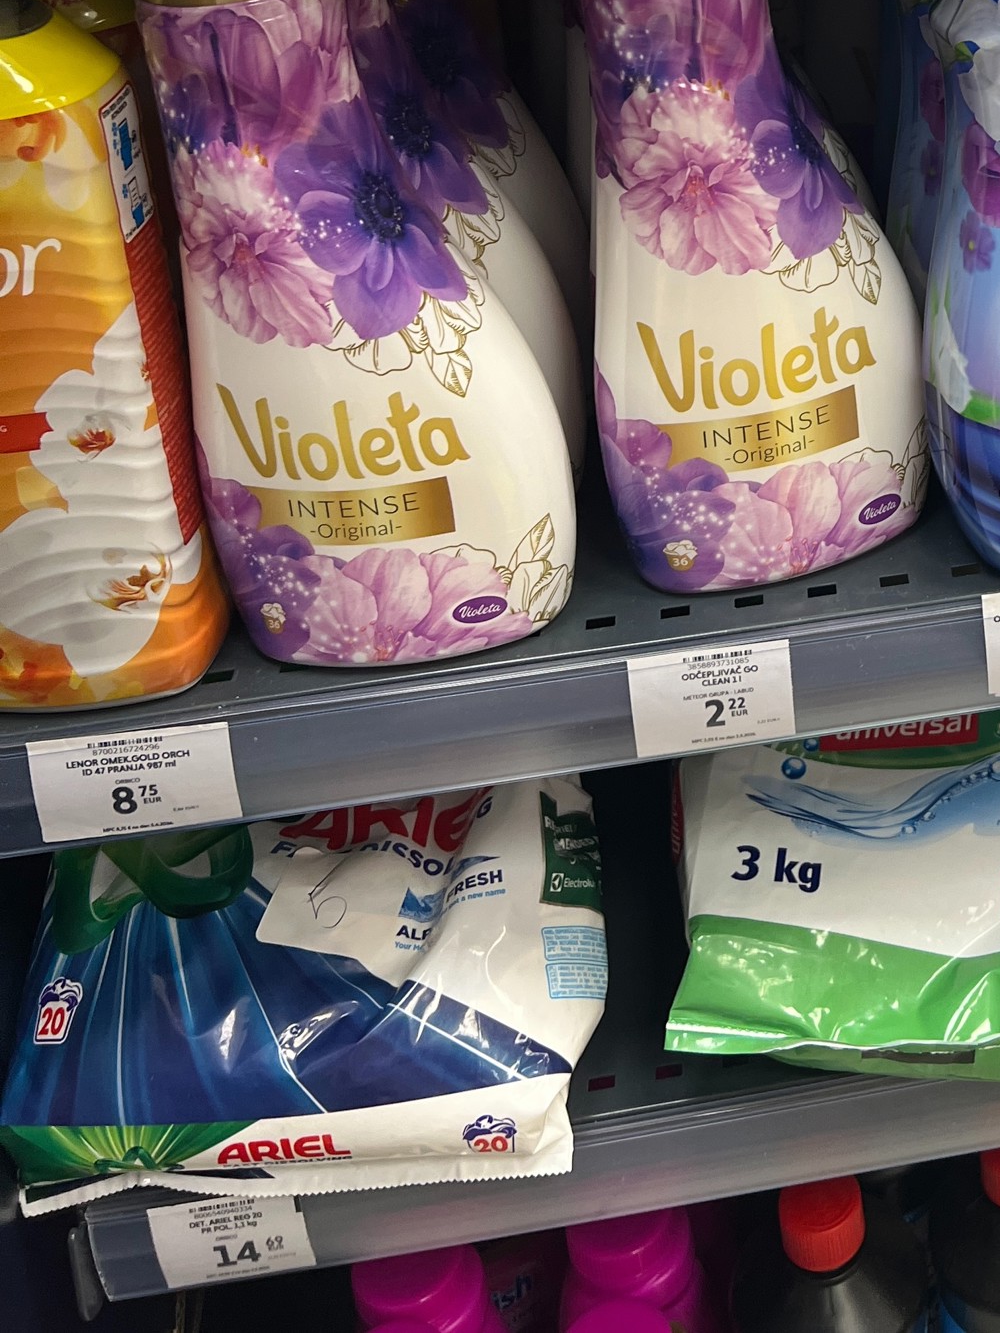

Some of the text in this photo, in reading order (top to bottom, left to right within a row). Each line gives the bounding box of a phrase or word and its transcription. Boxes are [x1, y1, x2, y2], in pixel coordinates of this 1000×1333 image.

[636, 306, 877, 413] Violeta
[216, 382, 471, 481] Violeta
[703, 404, 831, 448] INTENSE
[288, 491, 421, 519] INTENSE
[681, 665, 758, 681] ODČEPLJIVAČ GO
[701, 677, 731, 687] CLEAN
[705, 697, 746, 728] 2 22
[731, 709, 748, 717] EUR
[66, 750, 190, 769] LENOR ORCH
[107, 763, 145, 773] PRANJA
[112, 784, 158, 815] 8 75
[143, 796, 162, 805] EUR
[730, 844, 822, 893] 3 kg
[446, 869, 503, 904] FRESH
[38, 1007, 65, 1036] 20
[217, 1133, 351, 1164] ARIEL
[212, 1235, 283, 1268] 14 69
